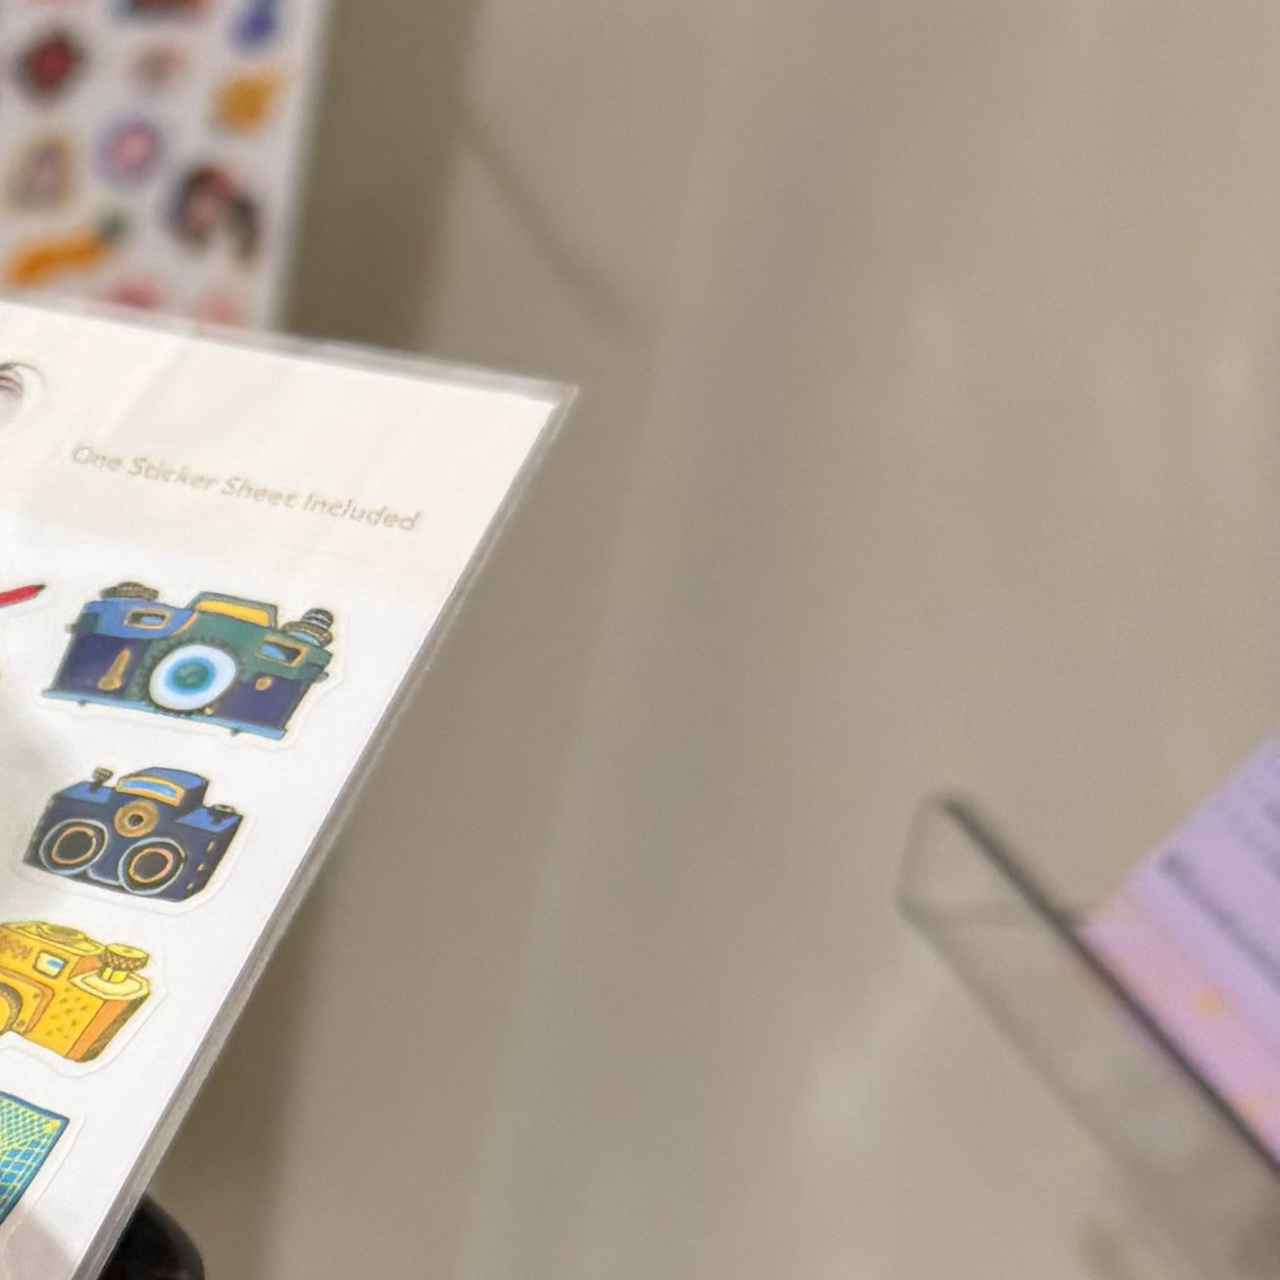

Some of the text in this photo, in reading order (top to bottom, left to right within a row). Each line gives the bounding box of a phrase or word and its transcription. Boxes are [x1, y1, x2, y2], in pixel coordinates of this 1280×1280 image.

[71, 445, 421, 531] One Sticker Sheet Included
